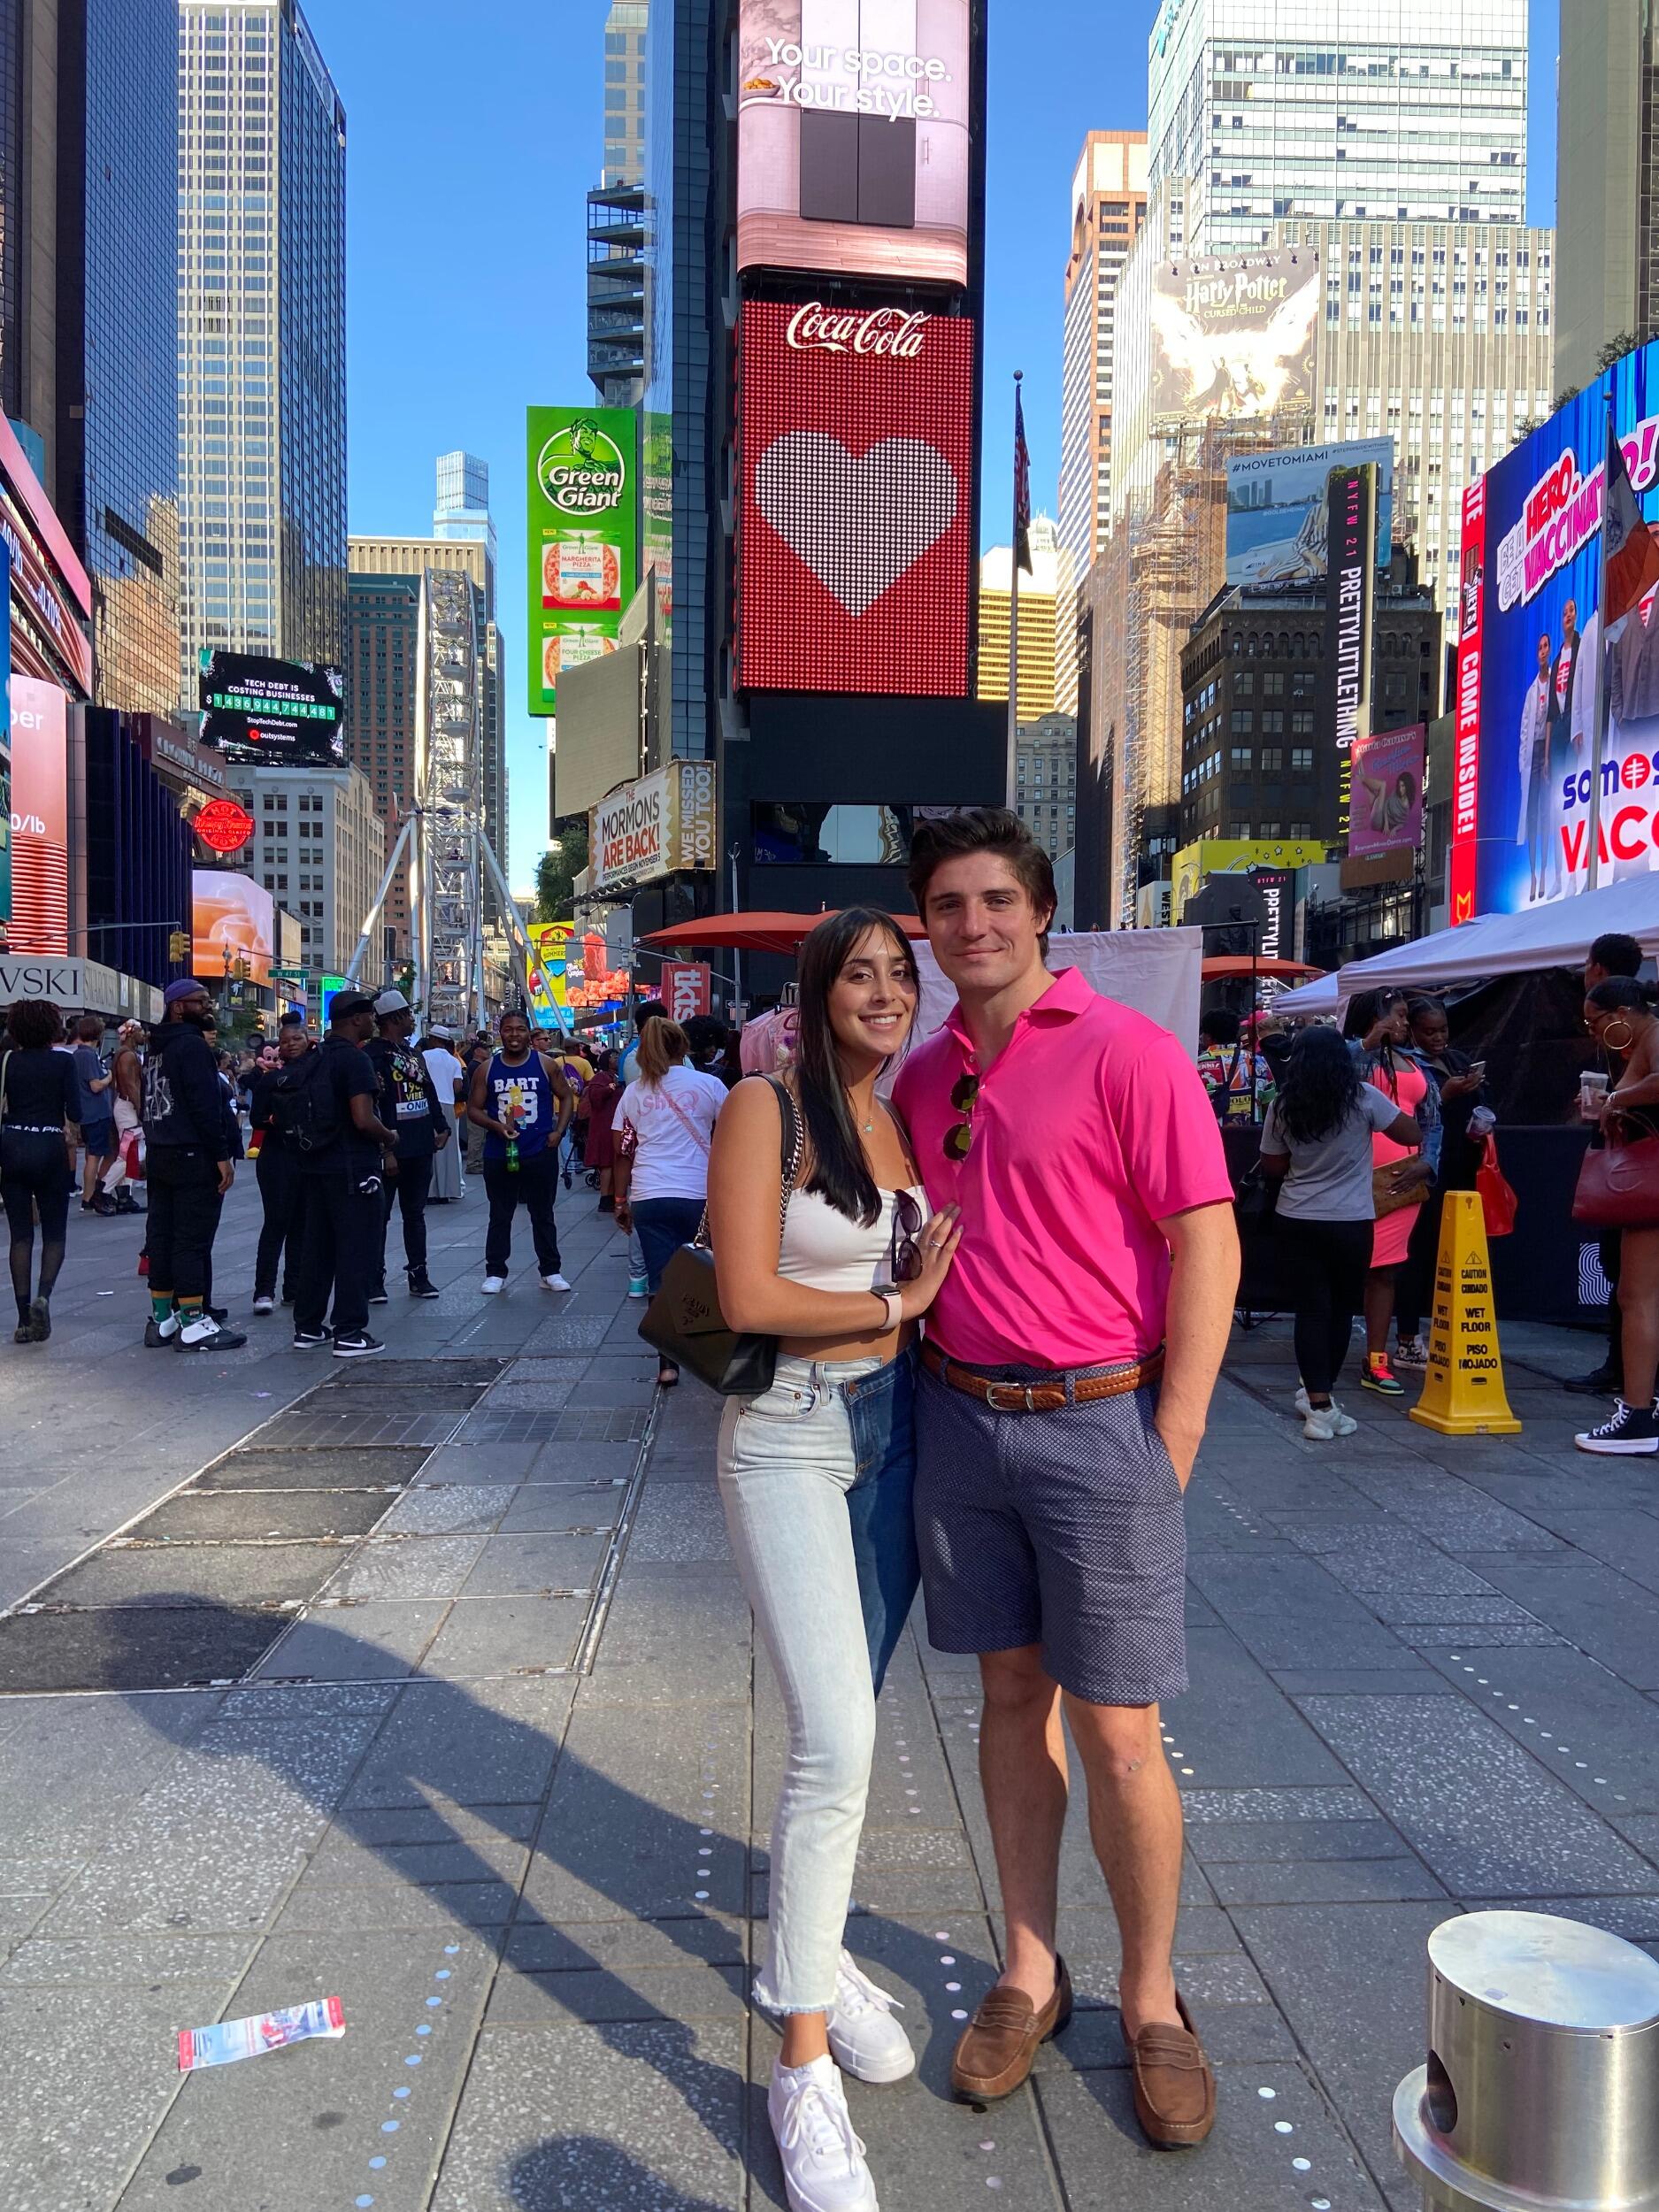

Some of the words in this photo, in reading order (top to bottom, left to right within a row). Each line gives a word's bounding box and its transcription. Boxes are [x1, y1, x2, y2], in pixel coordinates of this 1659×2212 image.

[764, 37, 836, 70] Your
[844, 48, 952, 82] space.
[778, 76, 849, 108] Your
[856, 87, 941, 122] style.
[1185, 279, 1234, 314] Harry
[1234, 273, 1288, 312] Potter
[1203, 308, 1237, 319] CURSED
[1239, 305, 1267, 315] CHILD
[549, 465, 620, 487] Green
[557, 486, 622, 509] Giant
[1346, 480, 1359, 526] NYFW
[1526, 455, 1580, 546] HERO.
[1345, 537, 1359, 557] 21
[1335, 566, 1362, 749] PRETTYLITTLETHING
[227, 686, 264, 696] COSTING
[266, 690, 315, 703] BUSINESSES
[244, 679, 265, 688] TECH
[268, 681, 289, 691] DEBT
[1460, 650, 1479, 732] COME
[247, 717, 298, 728] StopTechDebt.com
[260, 732, 296, 742] outsystems
[695, 765, 711, 815] TOO!
[1339, 760, 1352, 803] NYFW
[1456, 734, 1478, 835] INSIDE!
[626, 787, 635, 803] THE
[681, 765, 695, 829] MISSED
[602, 790, 660, 845] MORMONS
[1338, 816, 1350, 834] 21
[603, 839, 624, 872] ARE
[626, 822, 660, 863] BACK!
[681, 833, 695, 863] WE
[695, 820, 711, 860] YOU
[673, 969, 703, 1025] tkts
[494, 1077, 540, 1093] BART
[1461, 1269, 1487, 1279] CAUTION
[1464, 1307, 1486, 1318] WET
[1461, 1322, 1491, 1333] FLOOR
[1466, 1343, 1488, 1355] PISO
[1458, 1358, 1498, 1370] MOJADO
